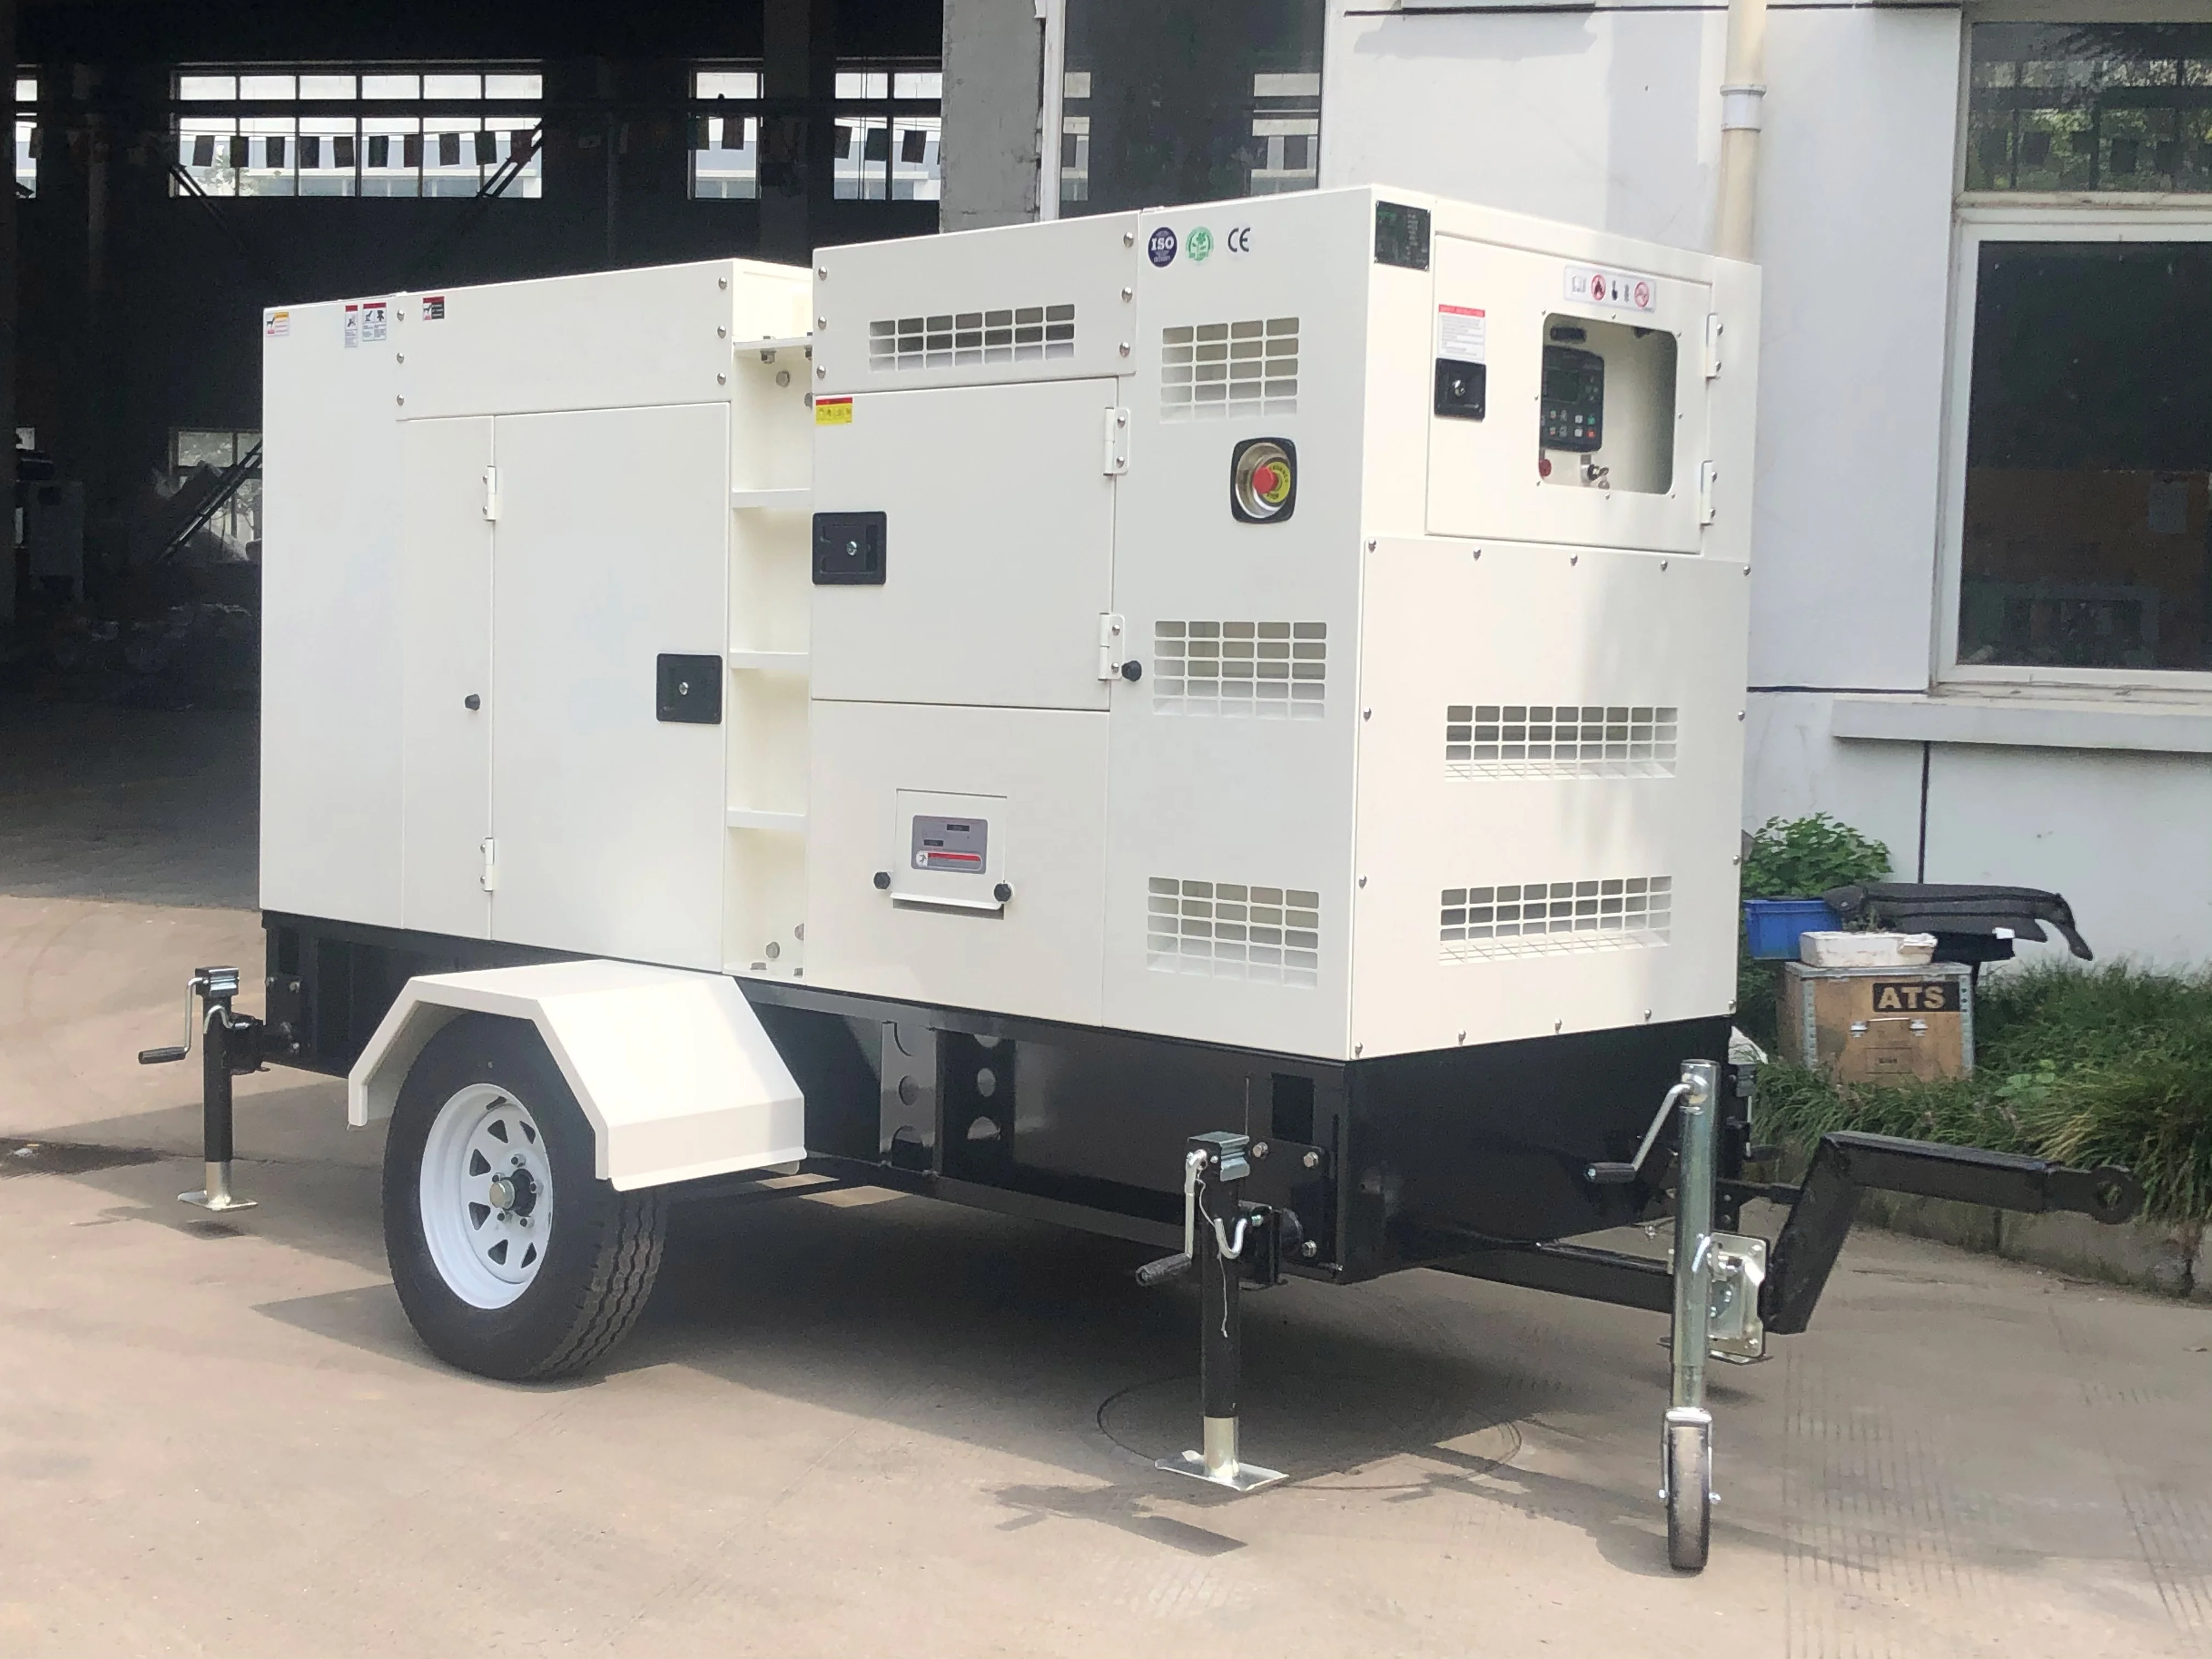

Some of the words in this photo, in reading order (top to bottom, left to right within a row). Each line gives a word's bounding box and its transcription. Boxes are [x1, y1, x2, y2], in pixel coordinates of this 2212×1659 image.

[1151, 236, 1174, 251] ISO
[1228, 227, 1251, 252] CE
[1878, 986, 1945, 1009] ATS
